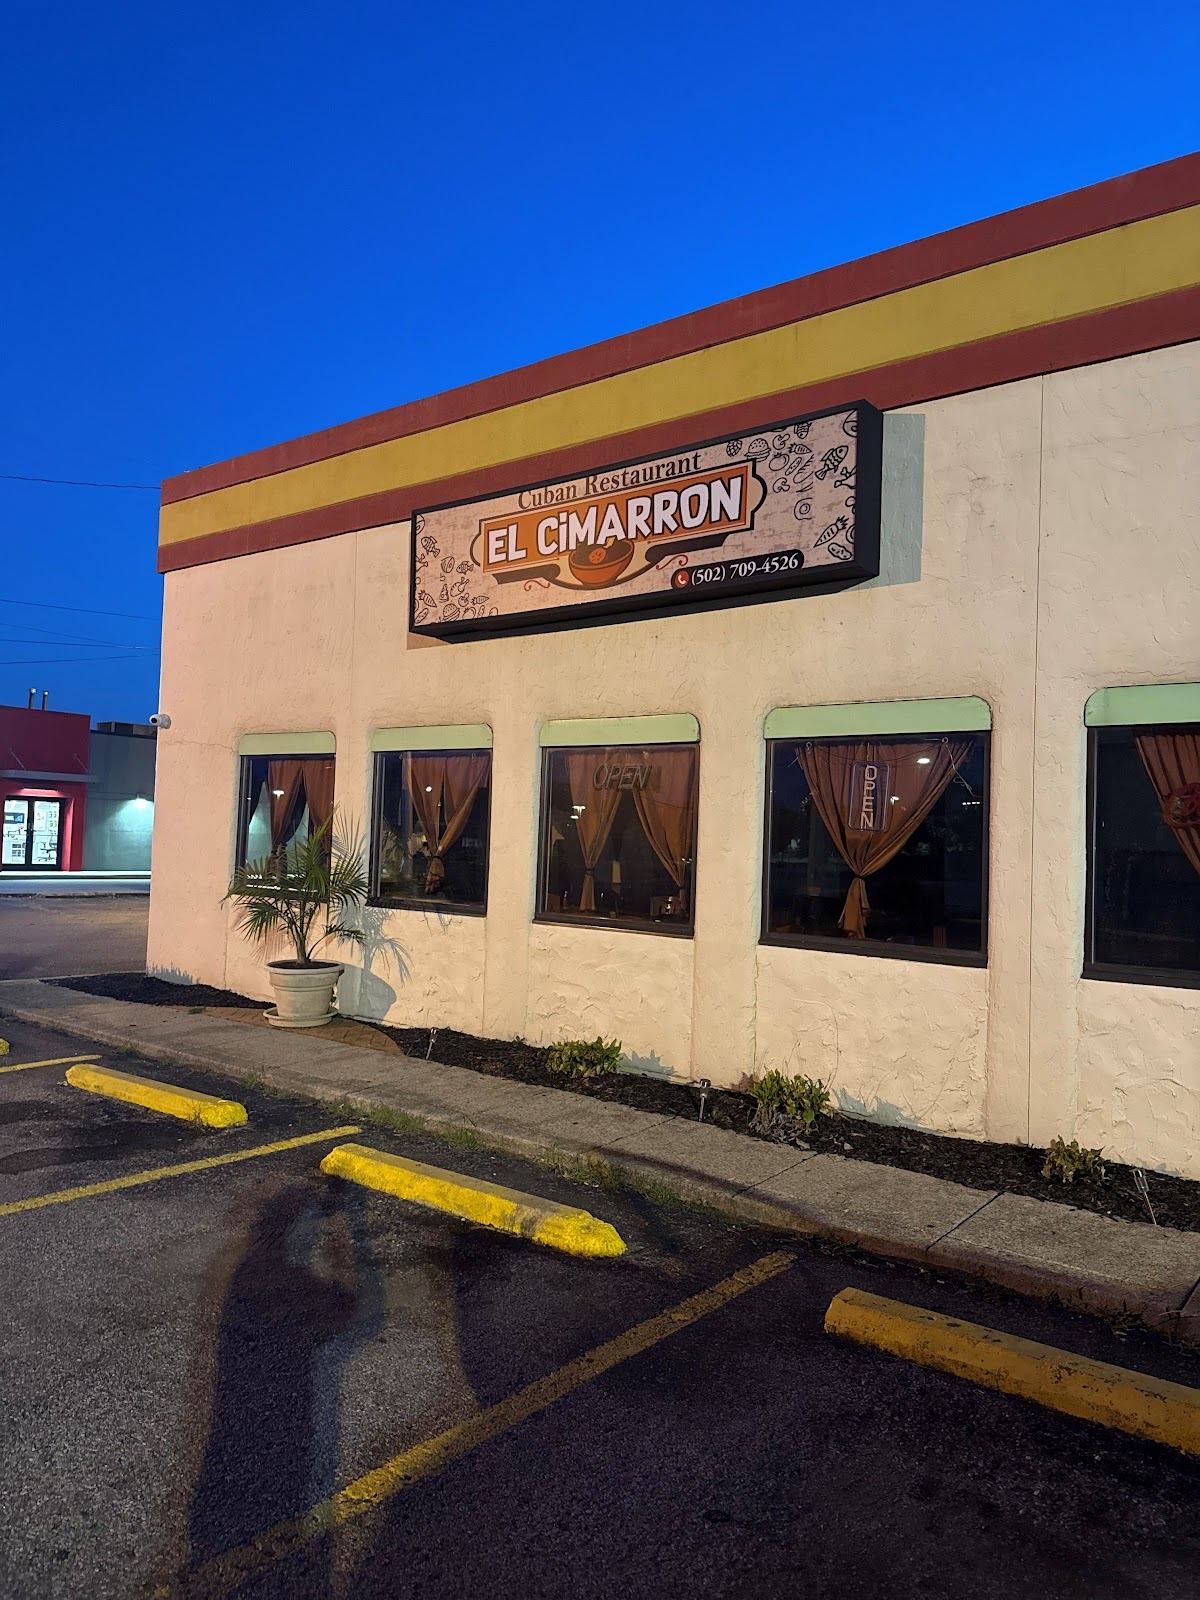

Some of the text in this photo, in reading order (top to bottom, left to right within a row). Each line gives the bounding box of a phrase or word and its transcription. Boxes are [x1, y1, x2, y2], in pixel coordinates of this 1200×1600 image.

[518, 451, 702, 510] Cuban Restaurant
[488, 523, 527, 565] EL
[691, 553, 800, 587] (502) 709-4526
[594, 763, 651, 791] OPEN
[860, 764, 877, 829] OPEN
